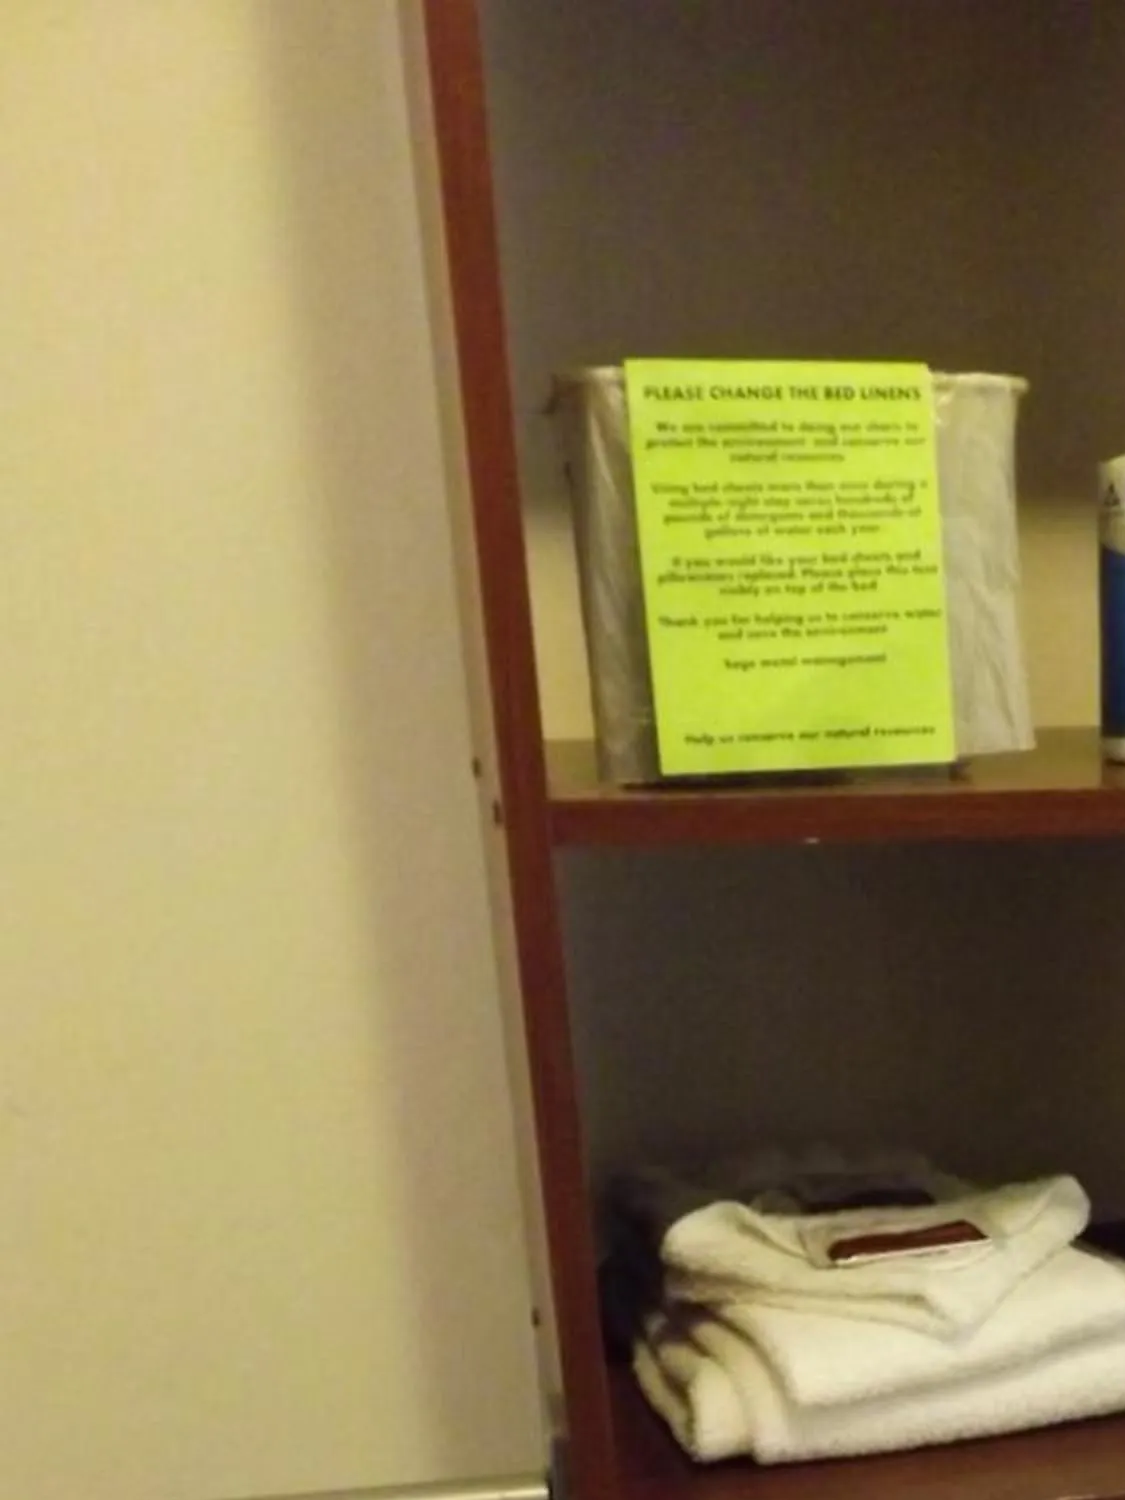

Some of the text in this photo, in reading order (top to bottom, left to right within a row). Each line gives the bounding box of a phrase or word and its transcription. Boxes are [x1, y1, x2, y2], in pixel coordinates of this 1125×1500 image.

[643, 386, 922, 401] PLEASE CHANGE THE BED LINENS
